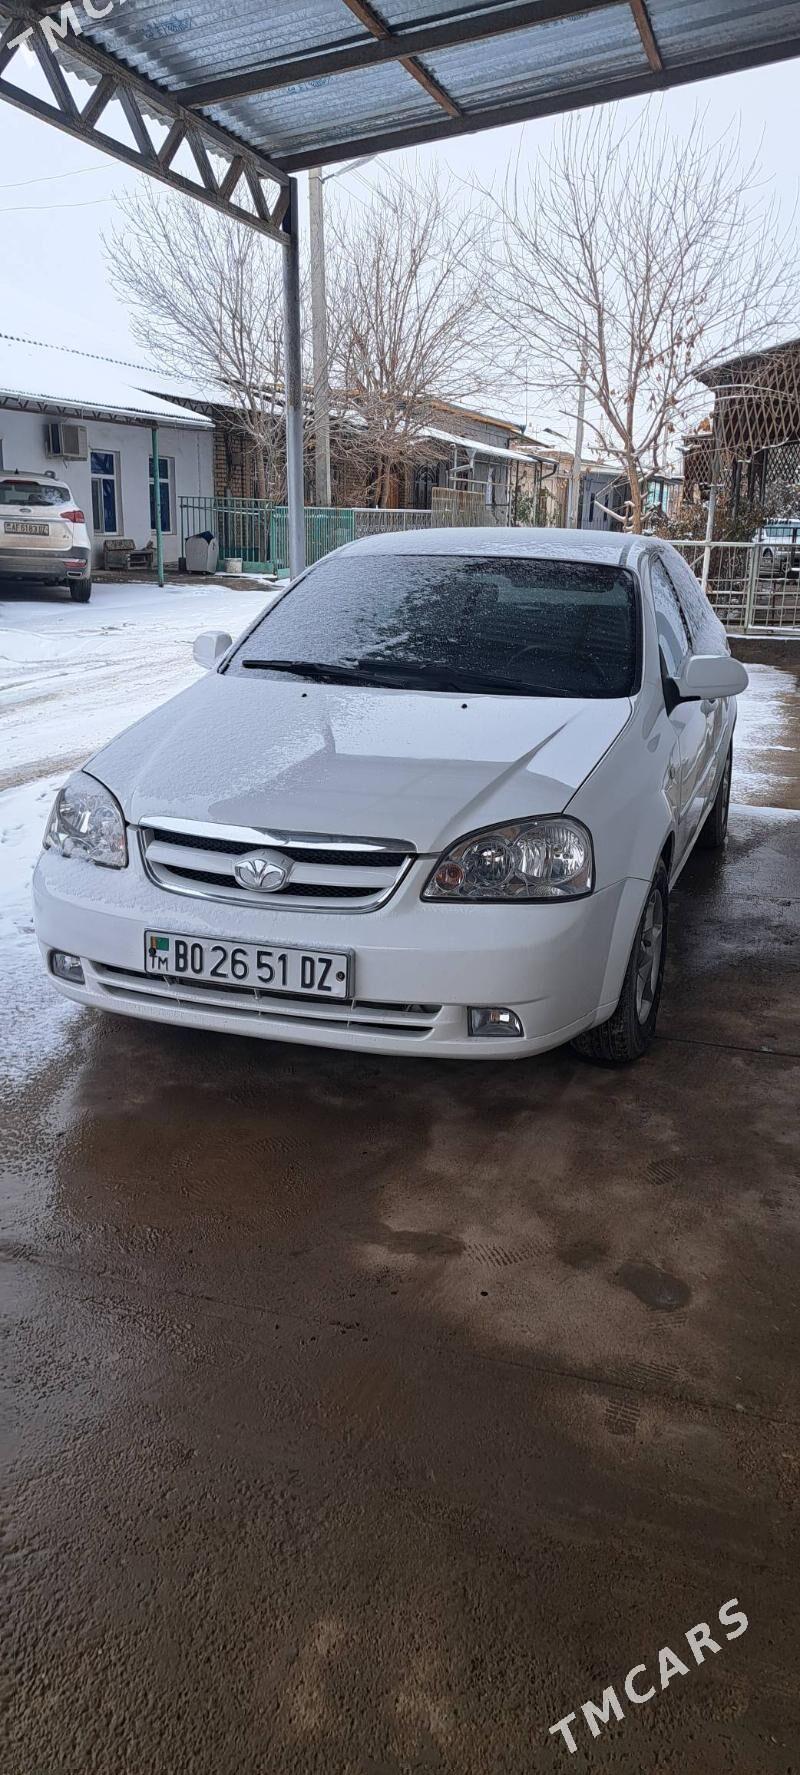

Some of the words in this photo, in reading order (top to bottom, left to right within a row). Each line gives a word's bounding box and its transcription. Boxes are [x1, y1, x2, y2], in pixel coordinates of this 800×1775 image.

[149, 955, 169, 971] TM
[210, 945, 249, 980] 26
[256, 950, 287, 987] 51
[300, 955, 332, 992] DZ
